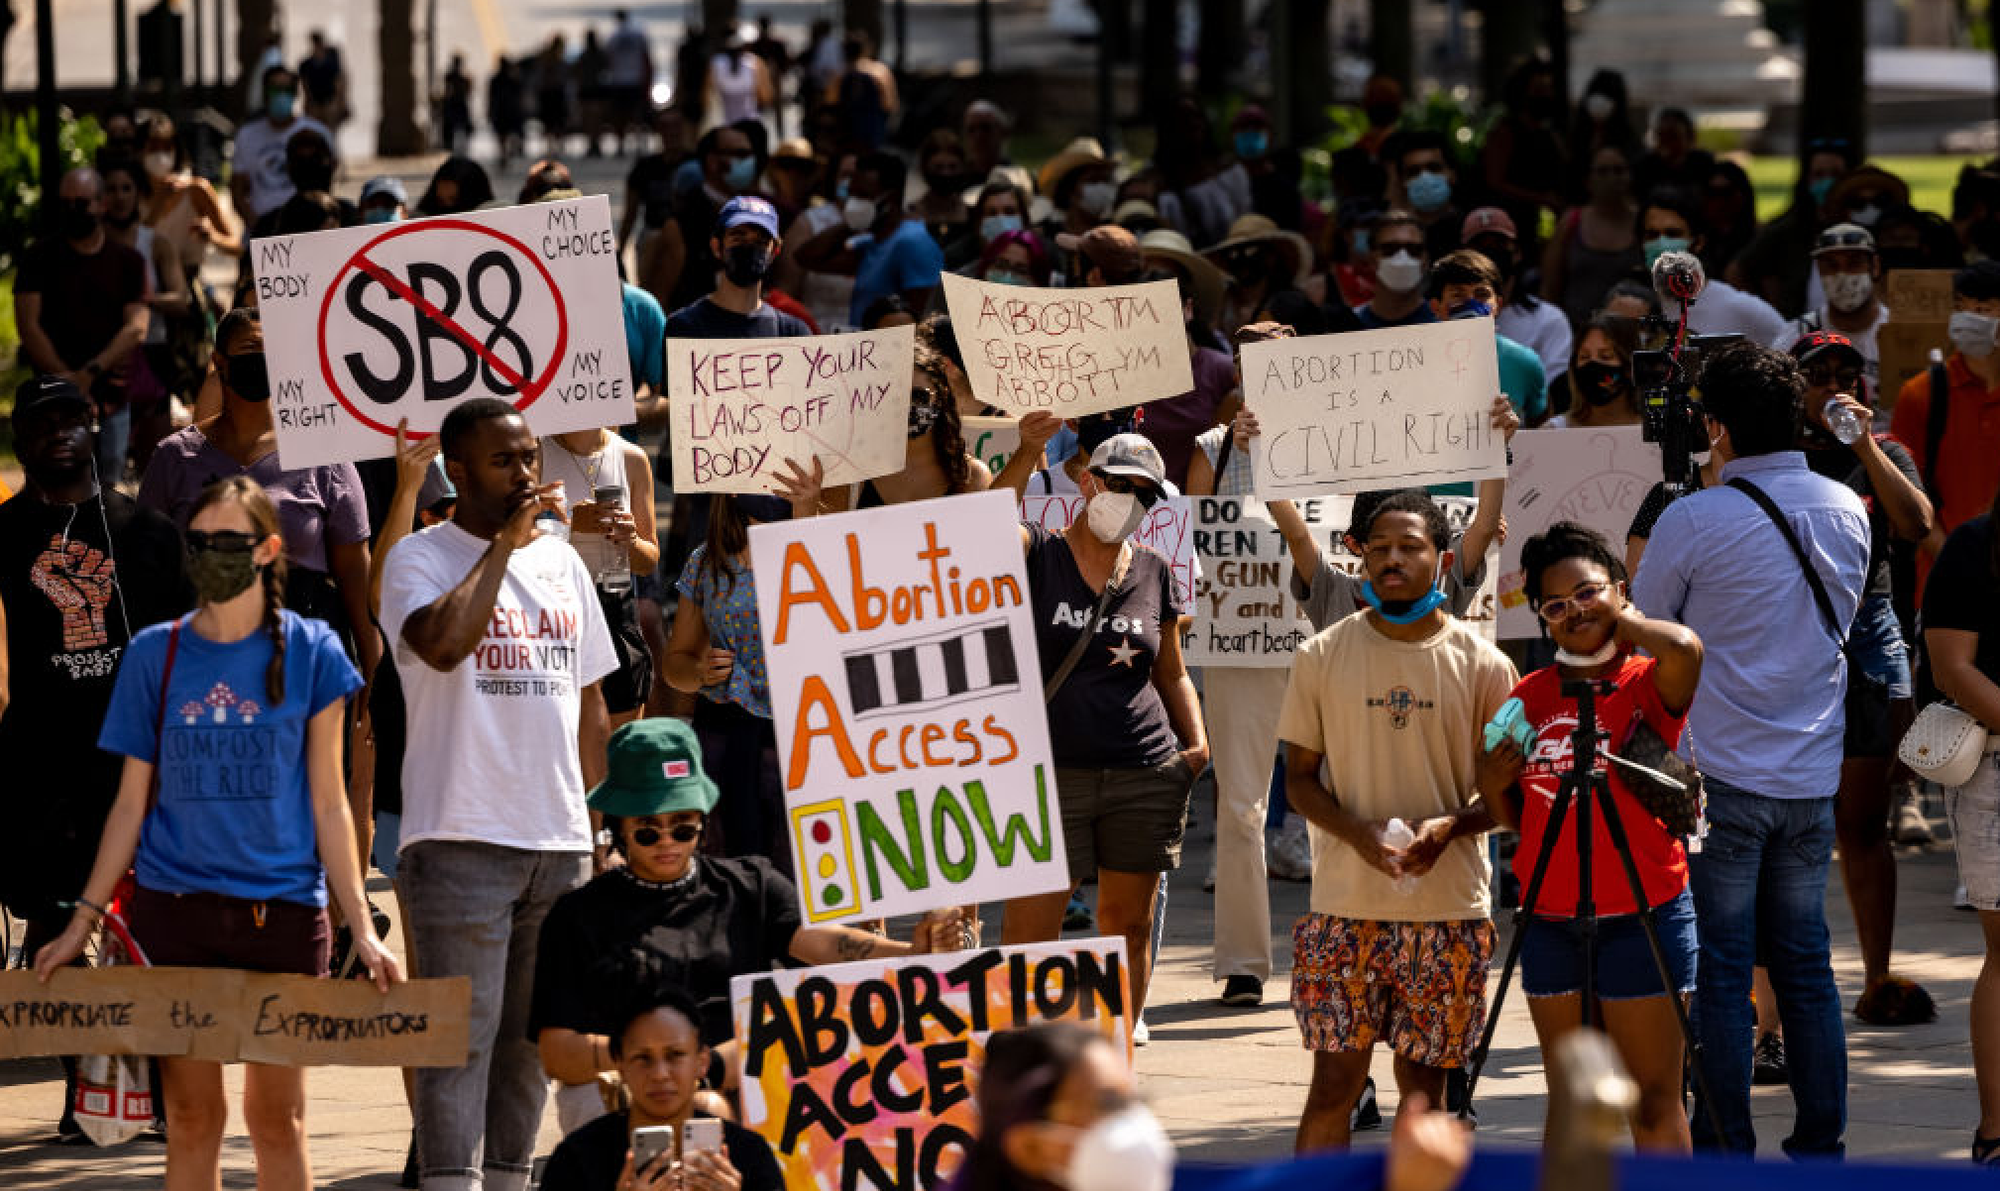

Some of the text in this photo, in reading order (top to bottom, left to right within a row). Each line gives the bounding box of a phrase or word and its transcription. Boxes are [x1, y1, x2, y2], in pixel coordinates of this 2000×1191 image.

[548, 207, 579, 231] MY
[261, 240, 294, 269] MY
[543, 230, 613, 260] CHOICE
[259, 274, 309, 300] BODY
[343, 250, 534, 405] SB8
[572, 350, 602, 378] MY
[691, 340, 878, 397] KEEP YOUR
[1262, 348, 1425, 395] ABORTION
[277, 378, 304, 405] MY
[557, 379, 623, 404] VOICE
[996, 374, 1120, 408] ABBOTT
[1328, 389, 1393, 411] IS A
[278, 403, 339, 429] RIGHT
[691, 382, 891, 440] LAWS OFF MY
[691, 444, 772, 484] BODY
[1268, 420, 1390, 480] CIVIL
[1200, 498, 1241, 524] DO
[773, 522, 1023, 645] Abortion
[1217, 560, 1281, 588] GUN
[1237, 591, 1283, 619] and
[475, 643, 533, 671] YOUR
[475, 679, 528, 696] PROTEST
[166, 730, 279, 760] COMPOST
[787, 675, 1019, 791] Access
[854, 763, 1052, 900] NOW
[171, 1001, 218, 1028] the
[744, 949, 1123, 1078] ABORTION
